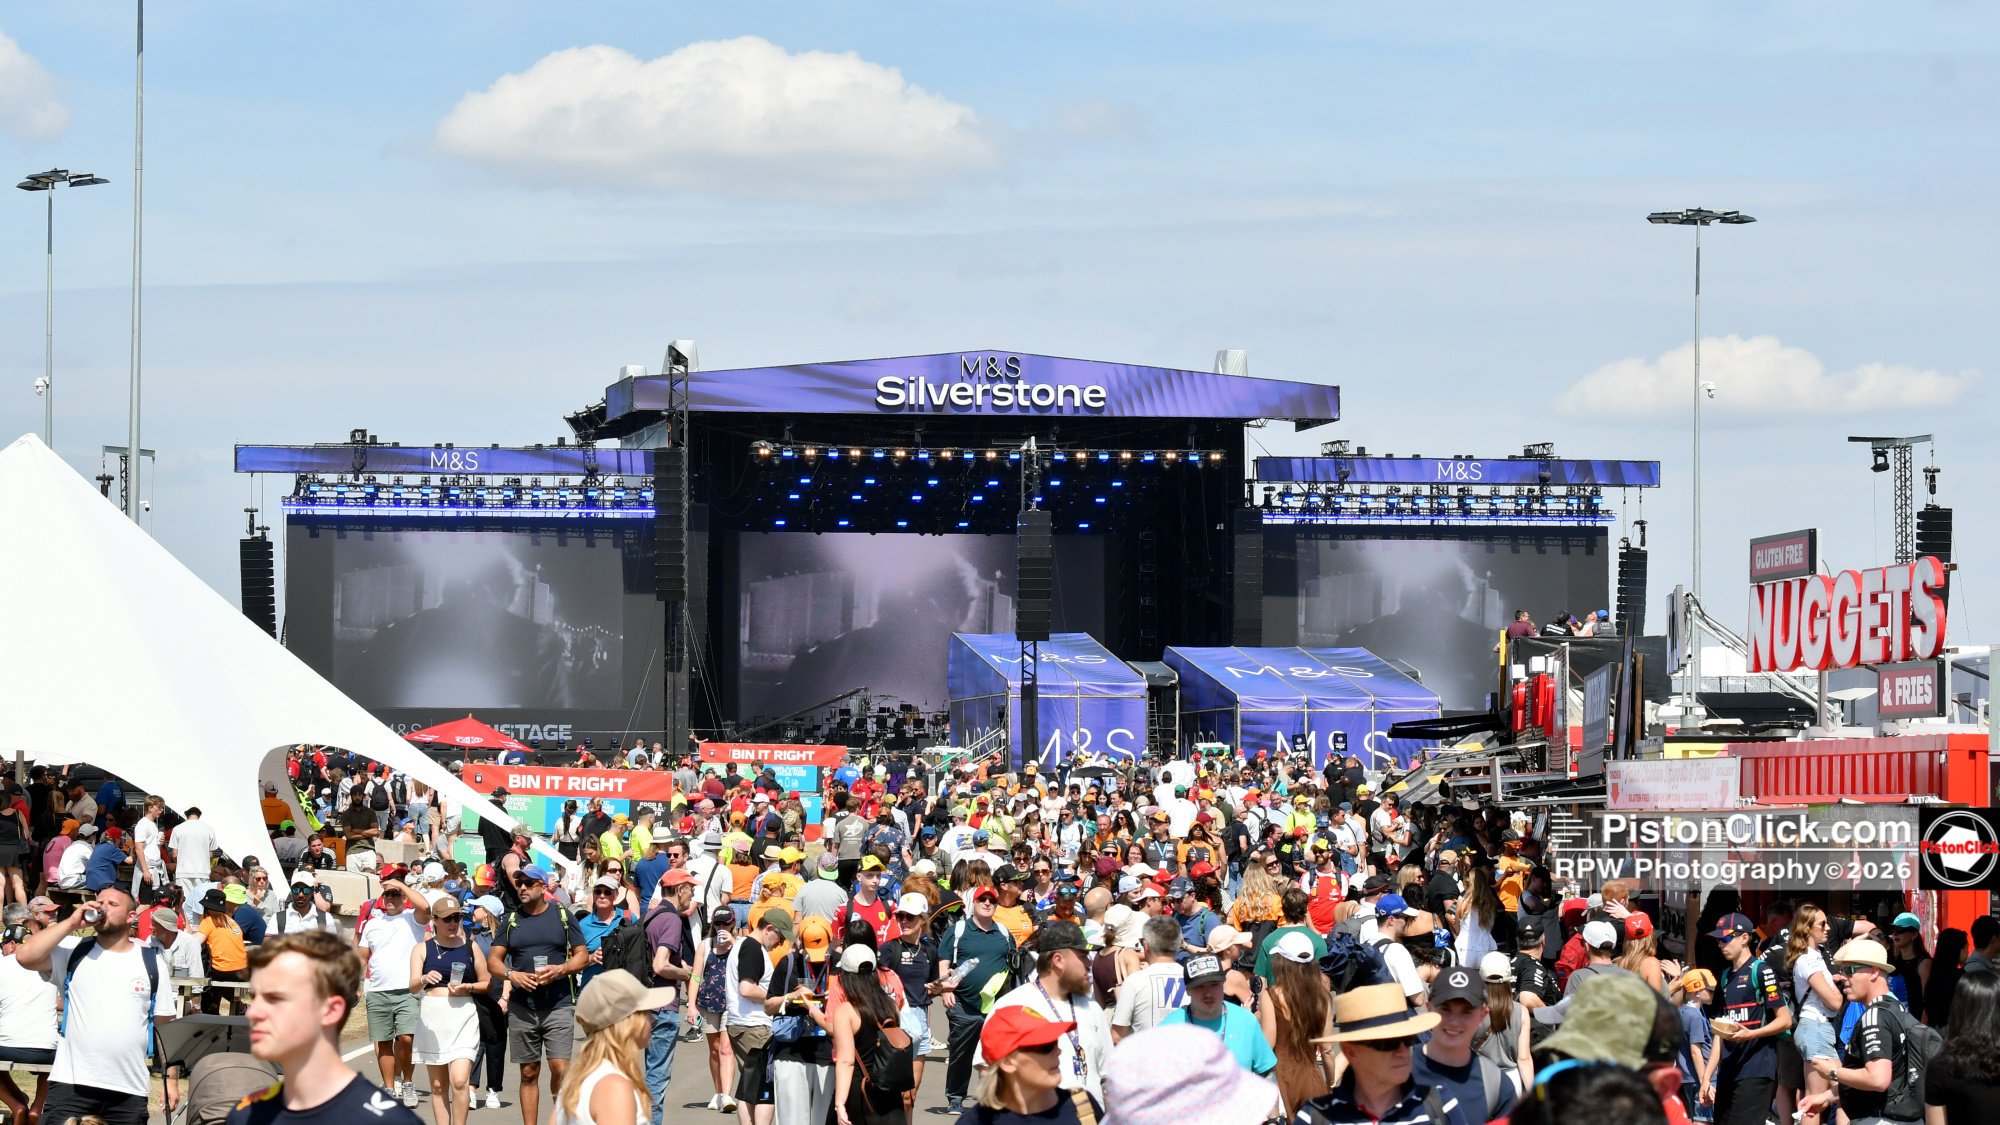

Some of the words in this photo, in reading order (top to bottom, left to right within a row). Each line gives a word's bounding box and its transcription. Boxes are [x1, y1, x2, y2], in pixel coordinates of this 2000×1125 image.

[961, 355, 1021, 378] M&S
[876, 376, 1107, 408] Silverstone
[431, 451, 478, 470] M&S
[1438, 462, 1482, 480] M&S
[1755, 545, 1784, 569] GLUTEN
[1785, 543, 1804, 565] FREE
[1747, 556, 1946, 673] NUGGETS
[1225, 665, 1374, 678] M&S
[1882, 677, 1893, 706] &
[1895, 675, 1933, 706] FRIES
[487, 724, 573, 741] STAGE
[732, 749, 755, 760] BIN
[758, 749, 771, 760] IT
[774, 750, 815, 761] RIGHT
[508, 774, 541, 789] BIN
[545, 775, 563, 790] IT
[567, 776, 628, 793] RIGHT
